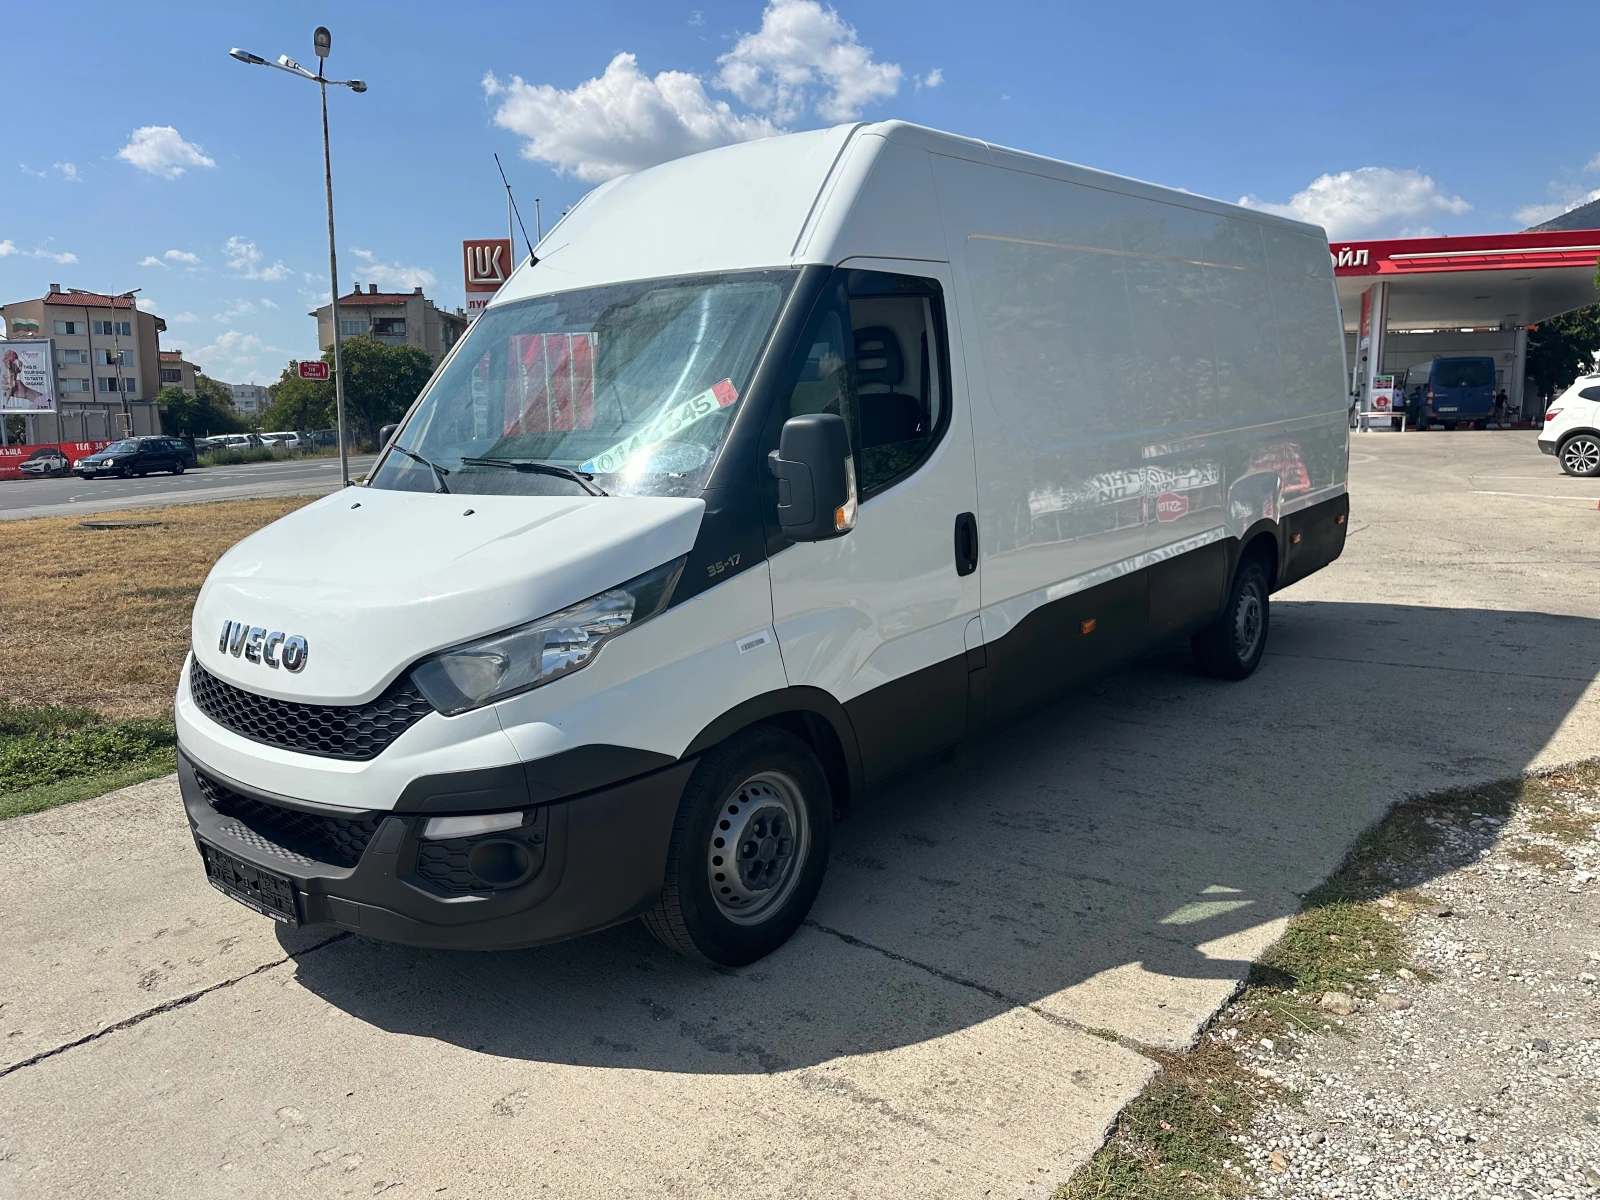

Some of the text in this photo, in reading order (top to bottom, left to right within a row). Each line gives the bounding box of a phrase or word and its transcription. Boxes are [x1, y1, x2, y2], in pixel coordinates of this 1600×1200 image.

[75, 443, 92, 451] ТЕЛ.
[95, 442, 104, 450] ЗА
[707, 553, 741, 577] 35-17
[219, 620, 308, 673] IVECO
